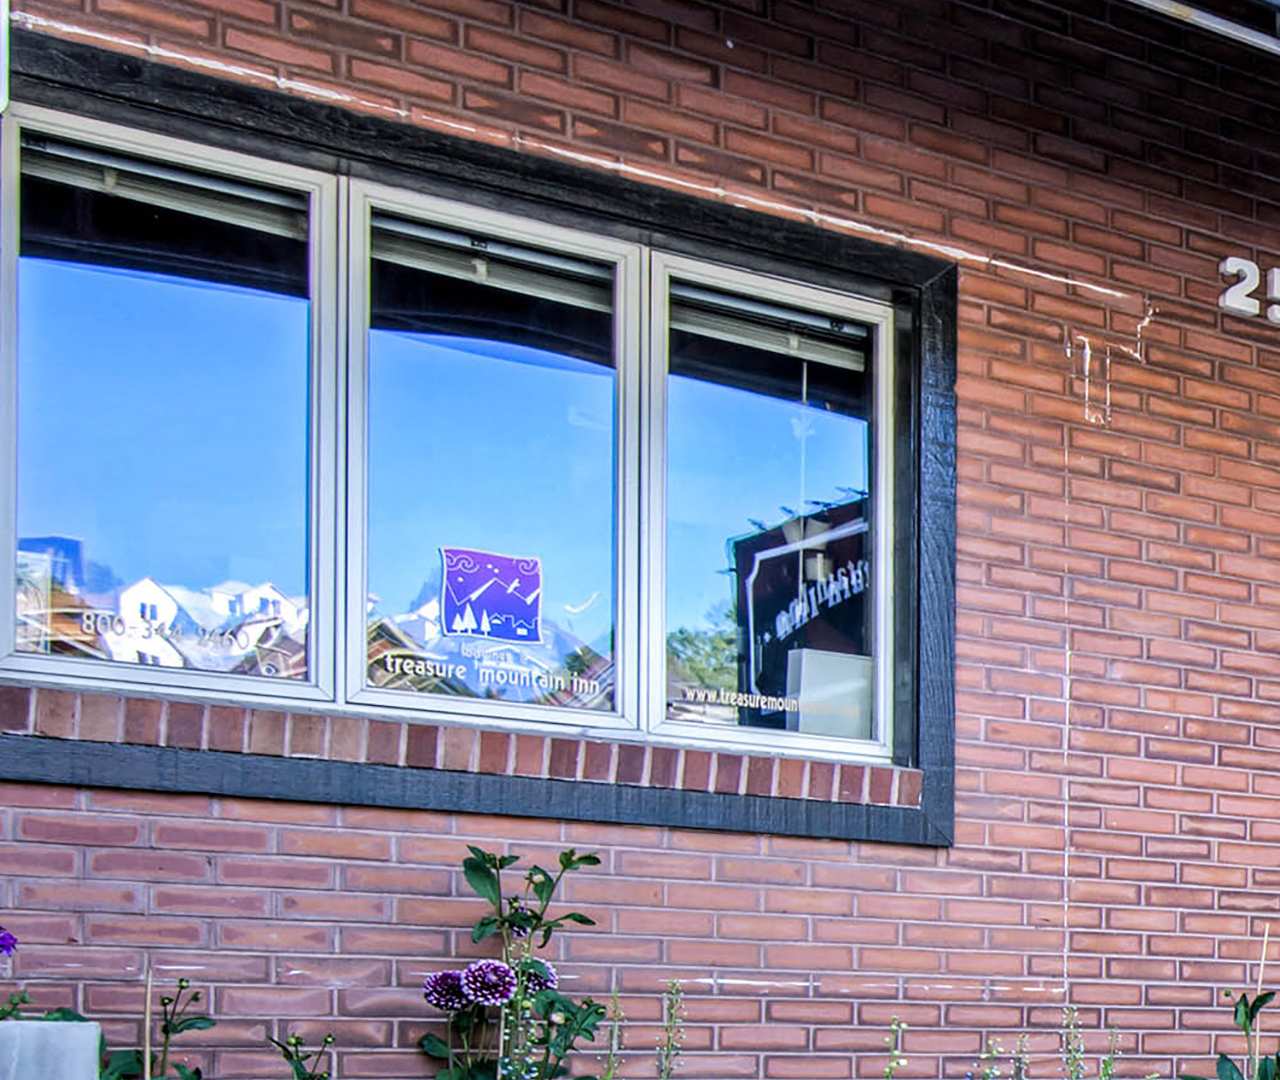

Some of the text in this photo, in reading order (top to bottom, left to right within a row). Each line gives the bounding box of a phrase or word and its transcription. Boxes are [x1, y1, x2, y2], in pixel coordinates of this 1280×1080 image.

[384, 653, 468, 680] treasure
[479, 666, 565, 692] mountain
[572, 671, 600, 695] inn
